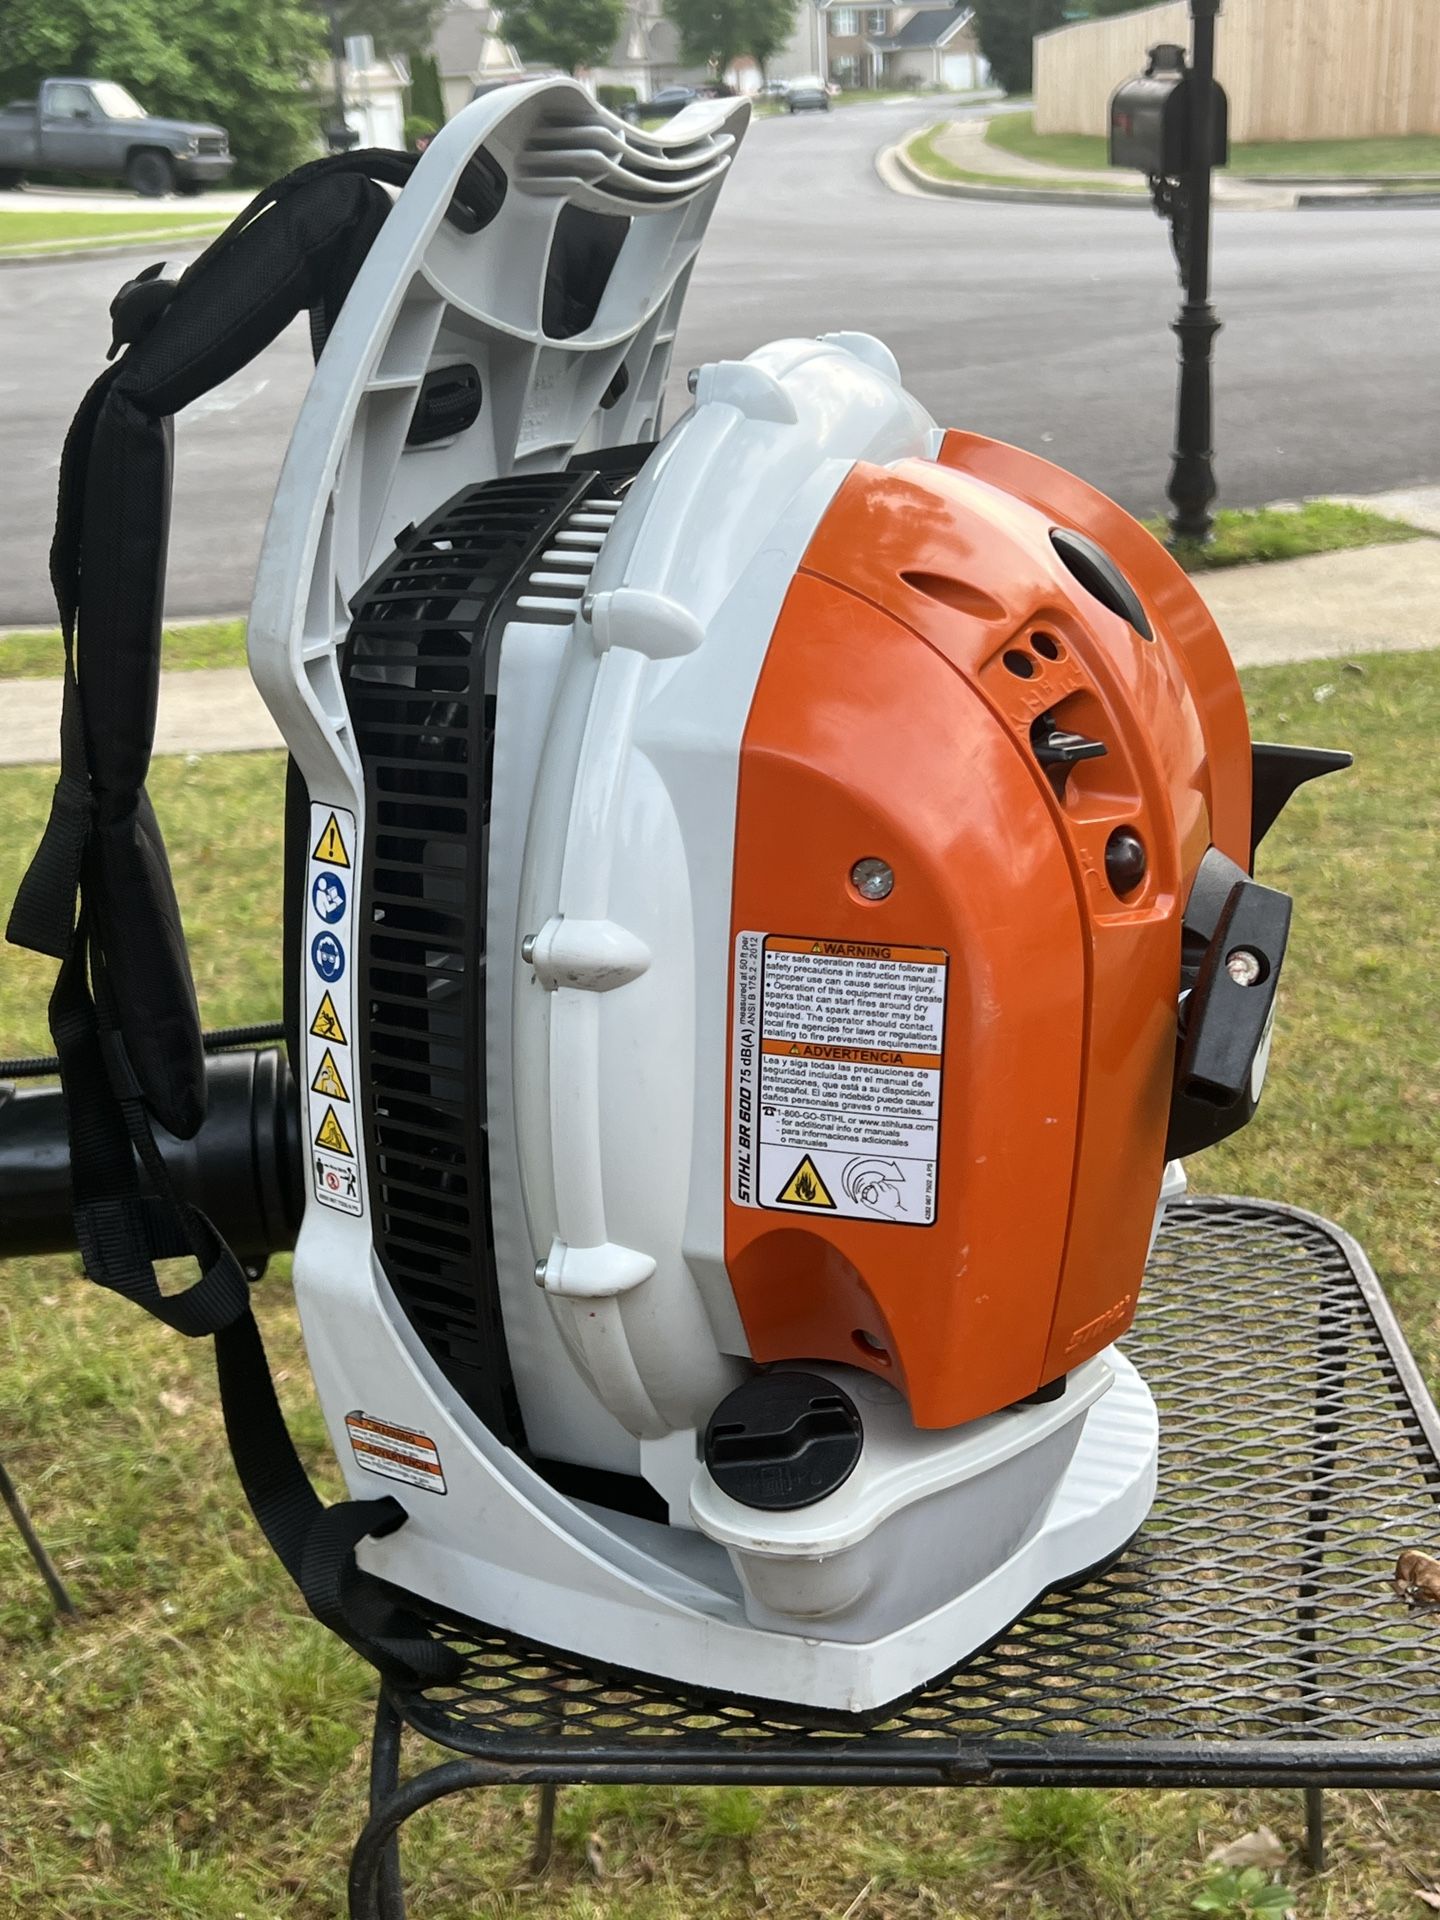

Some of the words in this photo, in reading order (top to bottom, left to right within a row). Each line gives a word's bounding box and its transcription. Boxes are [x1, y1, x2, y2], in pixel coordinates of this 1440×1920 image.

[824, 943, 891, 958] WARNING
[766, 962, 791, 972] safety
[794, 966, 843, 976] precautions
[856, 970, 900, 980] instruction
[903, 975, 935, 983] manual
[792, 955, 810, 963] safe
[813, 958, 853, 967] operation
[857, 961, 876, 969] read
[898, 964, 924, 973] follow
[766, 972, 804, 982] improper
[844, 980, 870, 988] cause
[873, 982, 906, 990] serious
[909, 985, 935, 994] injury.
[774, 982, 815, 992] Operation
[828, 987, 843, 995] this
[846, 989, 891, 999] equipment
[894, 993, 912, 1002] may
[915, 994, 942, 1003] create
[765, 990, 794, 1000] sparks
[835, 997, 854, 1005] start
[857, 998, 876, 1008] fires
[880, 1001, 910, 1010] around
[914, 1003, 928, 1013] dry
[765, 1001, 812, 1010] vegetation.
[825, 1006, 850, 1014] spark
[853, 1010, 889, 1018] arrester
[892, 1012, 911, 1022] may
[748, 1003, 756, 1026] ANSI
[764, 1010, 802, 1020] required.
[806, 1013, 823, 1022] The
[826, 1016, 864, 1025] operator
[866, 1020, 896, 1028] should
[900, 1022, 933, 1031] contact
[764, 1020, 784, 1028] local
[802, 1023, 840, 1032] agencies
[856, 1027, 875, 1036] laws
[890, 1030, 938, 1041] regulations
[764, 1029, 796, 1039] relating
[828, 1034, 874, 1044] prevention
[740, 1029, 756, 1066] dB(A)
[803, 1046, 903, 1064] ADVERTENCIA
[740, 1069, 751, 1083] 75
[763, 1066, 806, 1076] seguridad
[876, 1078, 909, 1086] manual
[764, 1056, 779, 1064] Lea
[790, 1060, 808, 1068] siga
[811, 1061, 835, 1070] todas
[854, 1066, 914, 1077] precauciones
[762, 1074, 820, 1088] instrucciones,
[882, 1086, 930, 1097] disposición
[740, 1087, 751, 1123] 600
[762, 1093, 788, 1102] daños
[791, 1098, 838, 1107] personales
[842, 1102, 871, 1110] graves
[883, 1106, 924, 1115] mortales.
[840, 1091, 874, 1102] indebido
[877, 1096, 904, 1104] puede
[778, 1110, 846, 1123] 1-800-GO-STIHL
[739, 1124, 750, 1150] BR
[795, 1120, 834, 1130] additional
[864, 1128, 900, 1137] manuals
[802, 1130, 859, 1141] informaciones
[862, 1136, 908, 1146] adicionales
[788, 1138, 828, 1148] manuales
[738, 1151, 750, 1203] STIHL
